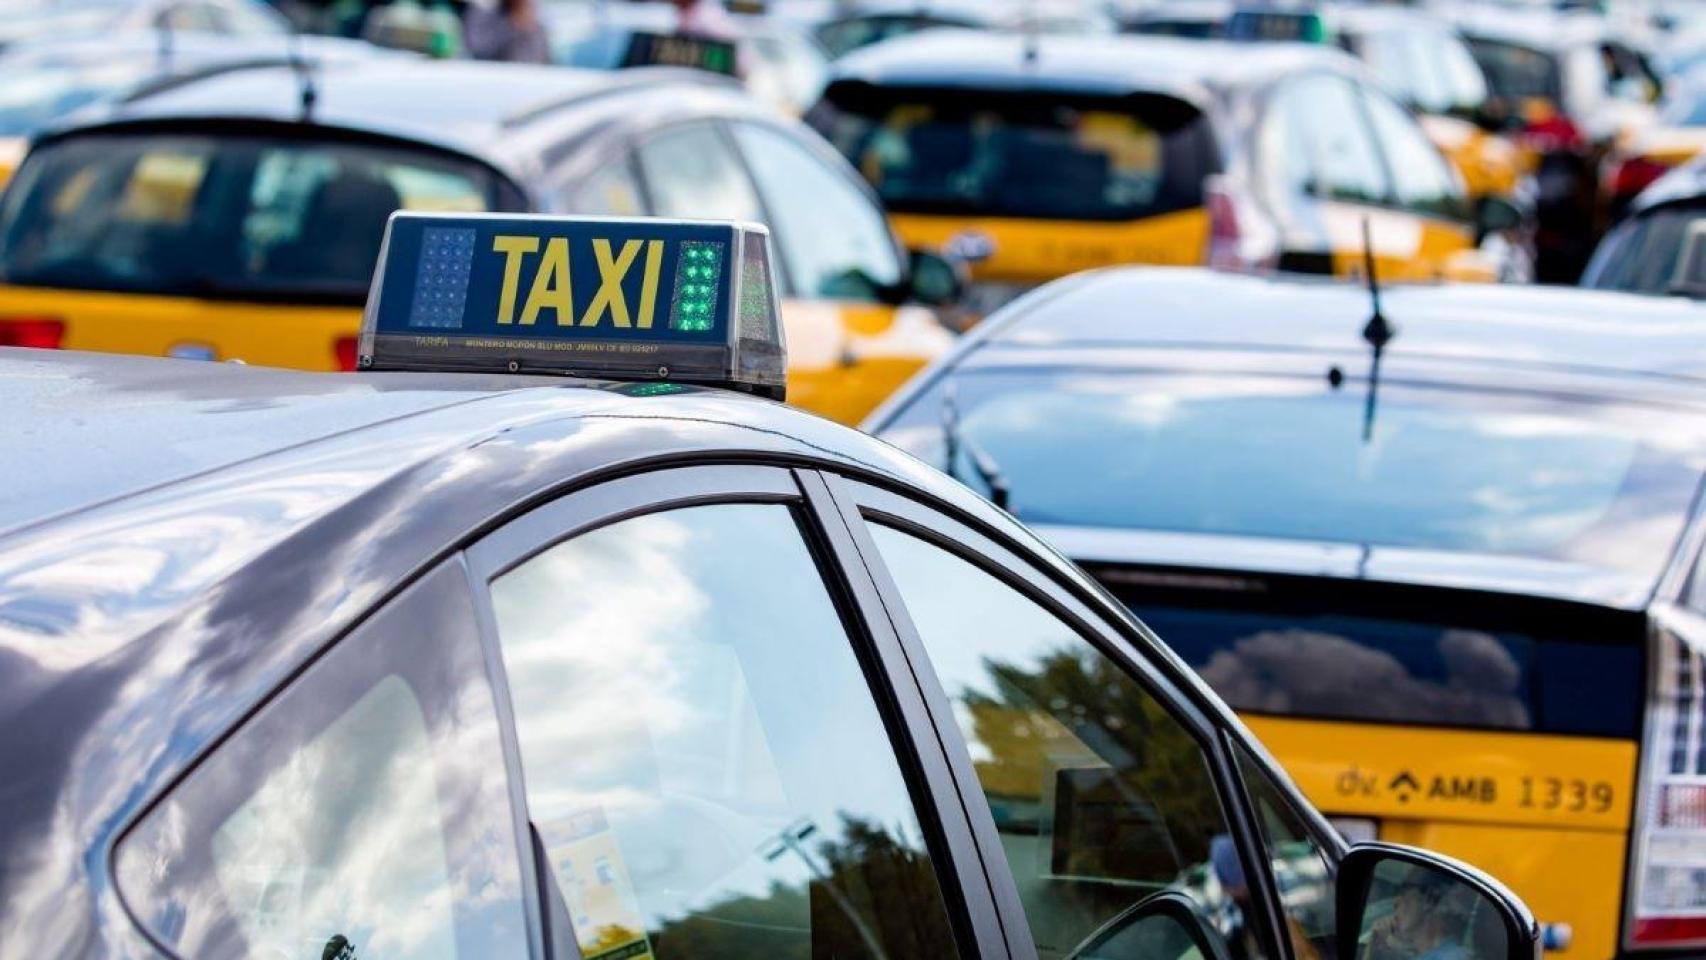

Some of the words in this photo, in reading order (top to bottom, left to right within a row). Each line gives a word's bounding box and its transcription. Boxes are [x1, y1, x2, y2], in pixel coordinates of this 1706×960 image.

[492, 236, 665, 329] TAXI
[1429, 775, 1498, 803] AMB
[1517, 776, 1613, 813] 1339
